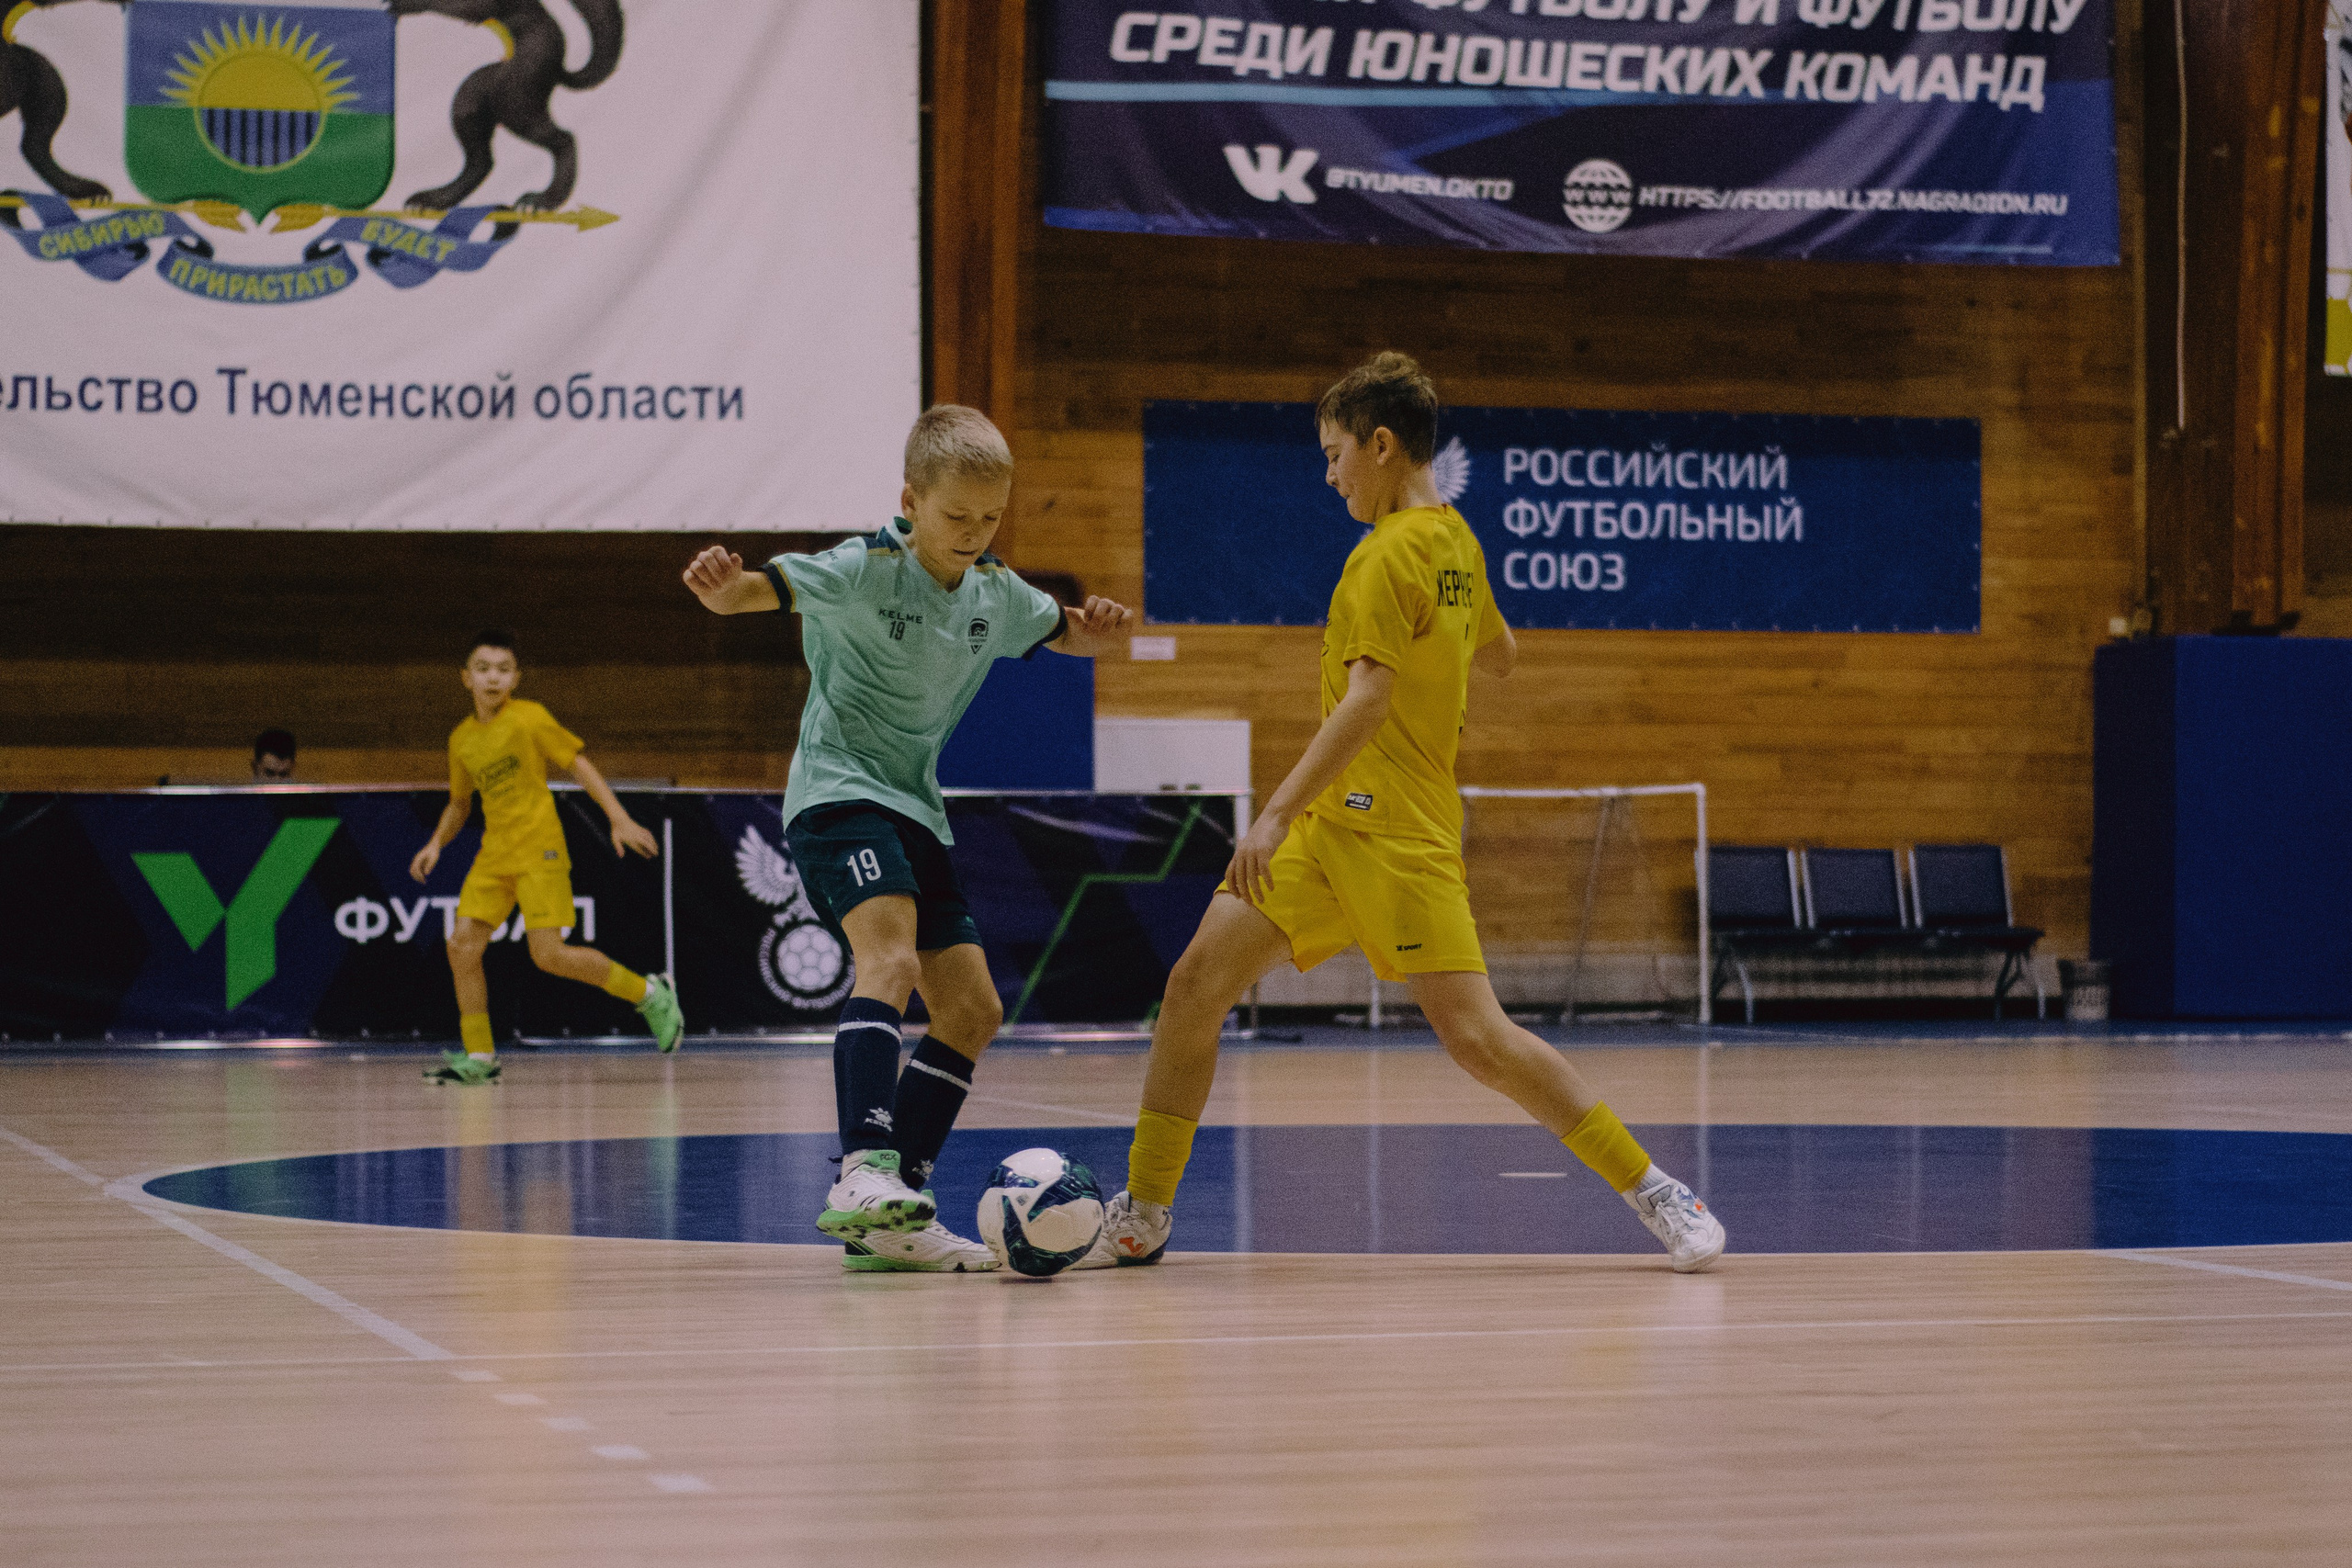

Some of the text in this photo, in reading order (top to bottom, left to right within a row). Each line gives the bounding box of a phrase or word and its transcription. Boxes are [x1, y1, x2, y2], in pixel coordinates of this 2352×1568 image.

[1110, 13, 2046, 112] СРЕДИ ЮНОШЕСКИХ КОМАНД
[169, 259, 347, 301] ПРИРАСТАТЬ
[216, 367, 516, 420] Тюменской
[534, 372, 744, 420] области
[1503, 441, 1788, 490] РОССИЙСКИЙ
[1503, 496, 1804, 542] ФУТБОЛЬНЫЙ
[1503, 551, 1626, 591] СОЮЗ
[878, 609, 923, 625] KELME
[889, 620, 906, 640] 19
[846, 848, 882, 887] 19
[334, 895, 596, 943] ФУТЛ
